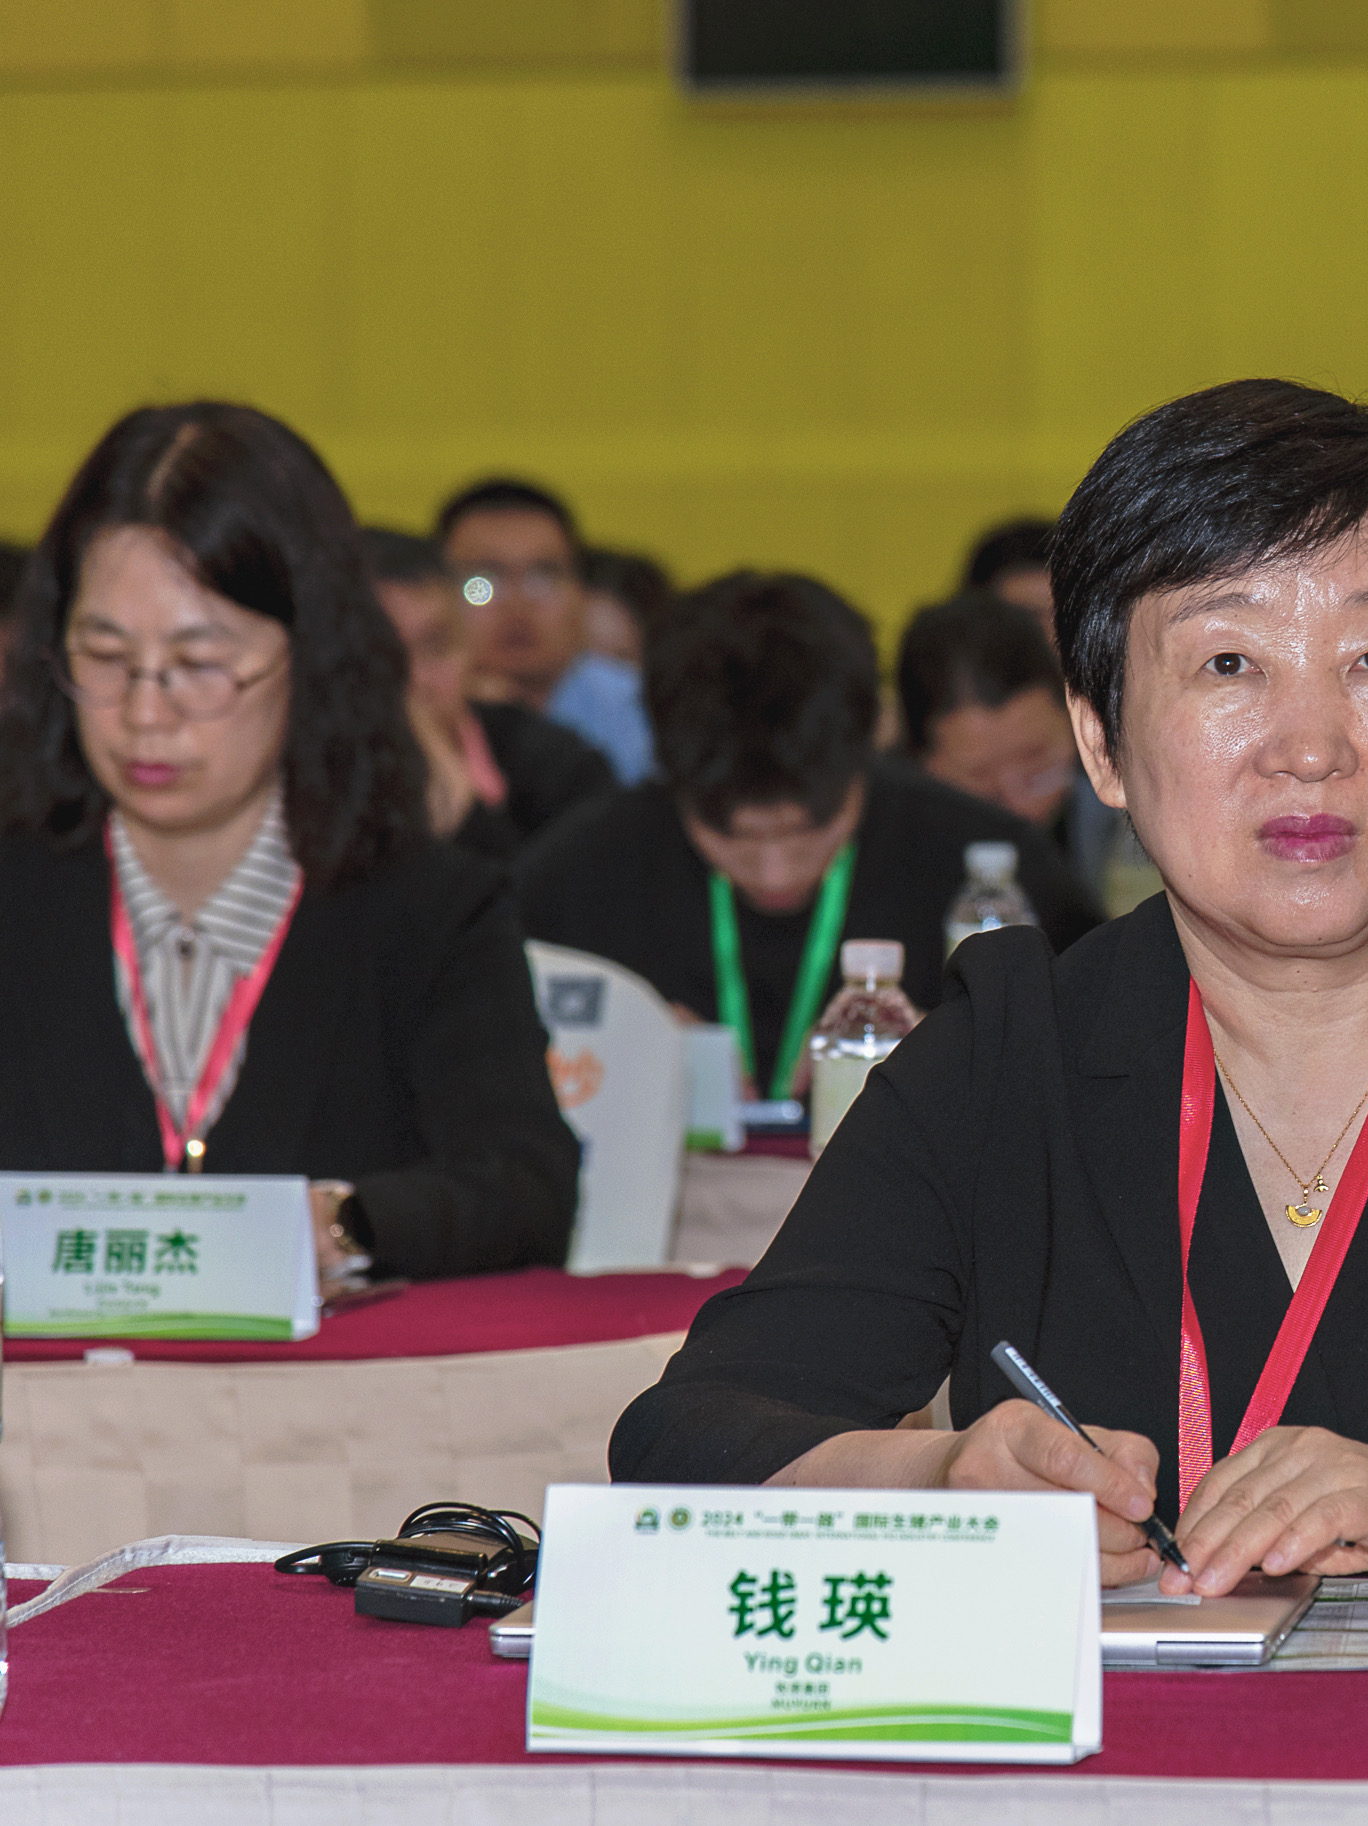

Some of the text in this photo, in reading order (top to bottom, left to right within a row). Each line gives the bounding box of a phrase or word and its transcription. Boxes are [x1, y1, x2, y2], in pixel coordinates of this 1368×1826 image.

[53, 1227, 199, 1275] 唐丽杰
[702, 1510, 744, 1527] 2024
[728, 1569, 796, 1641] 钱
[743, 1650, 863, 1678] Ying Qian
